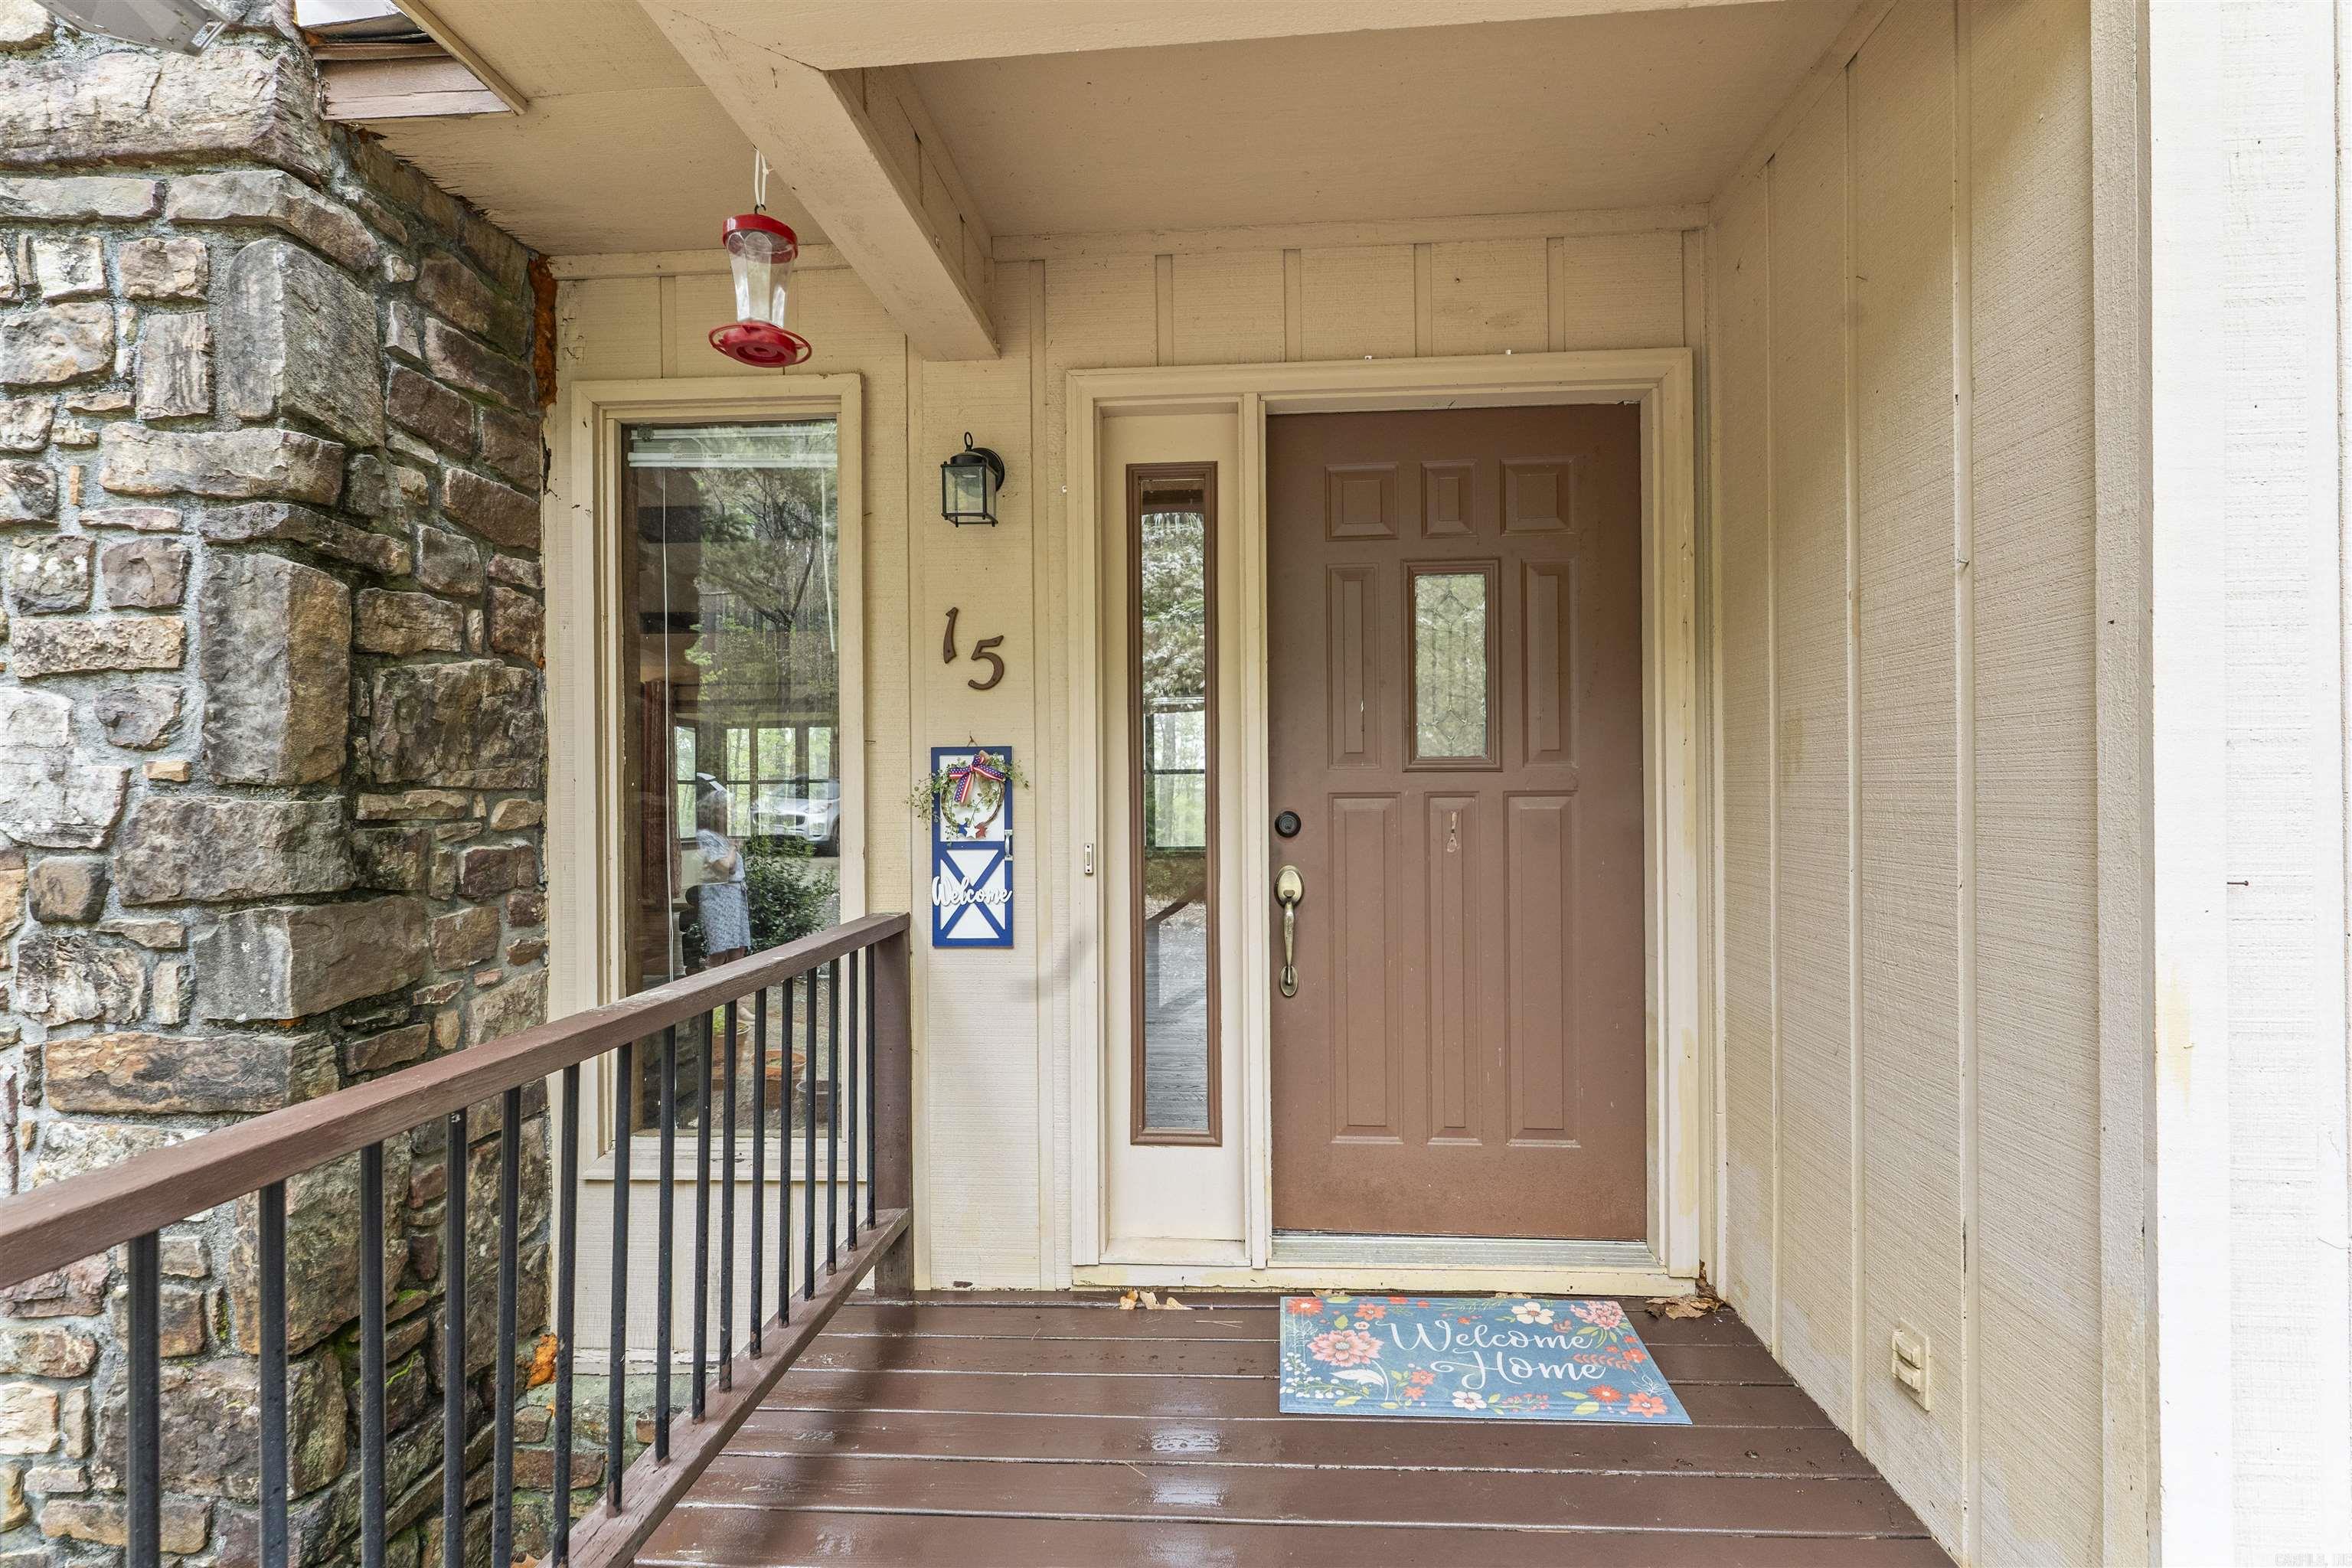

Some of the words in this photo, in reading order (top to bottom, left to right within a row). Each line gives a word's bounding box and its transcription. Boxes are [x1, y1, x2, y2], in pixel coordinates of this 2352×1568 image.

[942, 606, 1004, 691] 15
[932, 876, 1012, 906] Welcome
[1375, 1319, 1592, 1351] Welcome
[1430, 1348, 1606, 1390] Home
